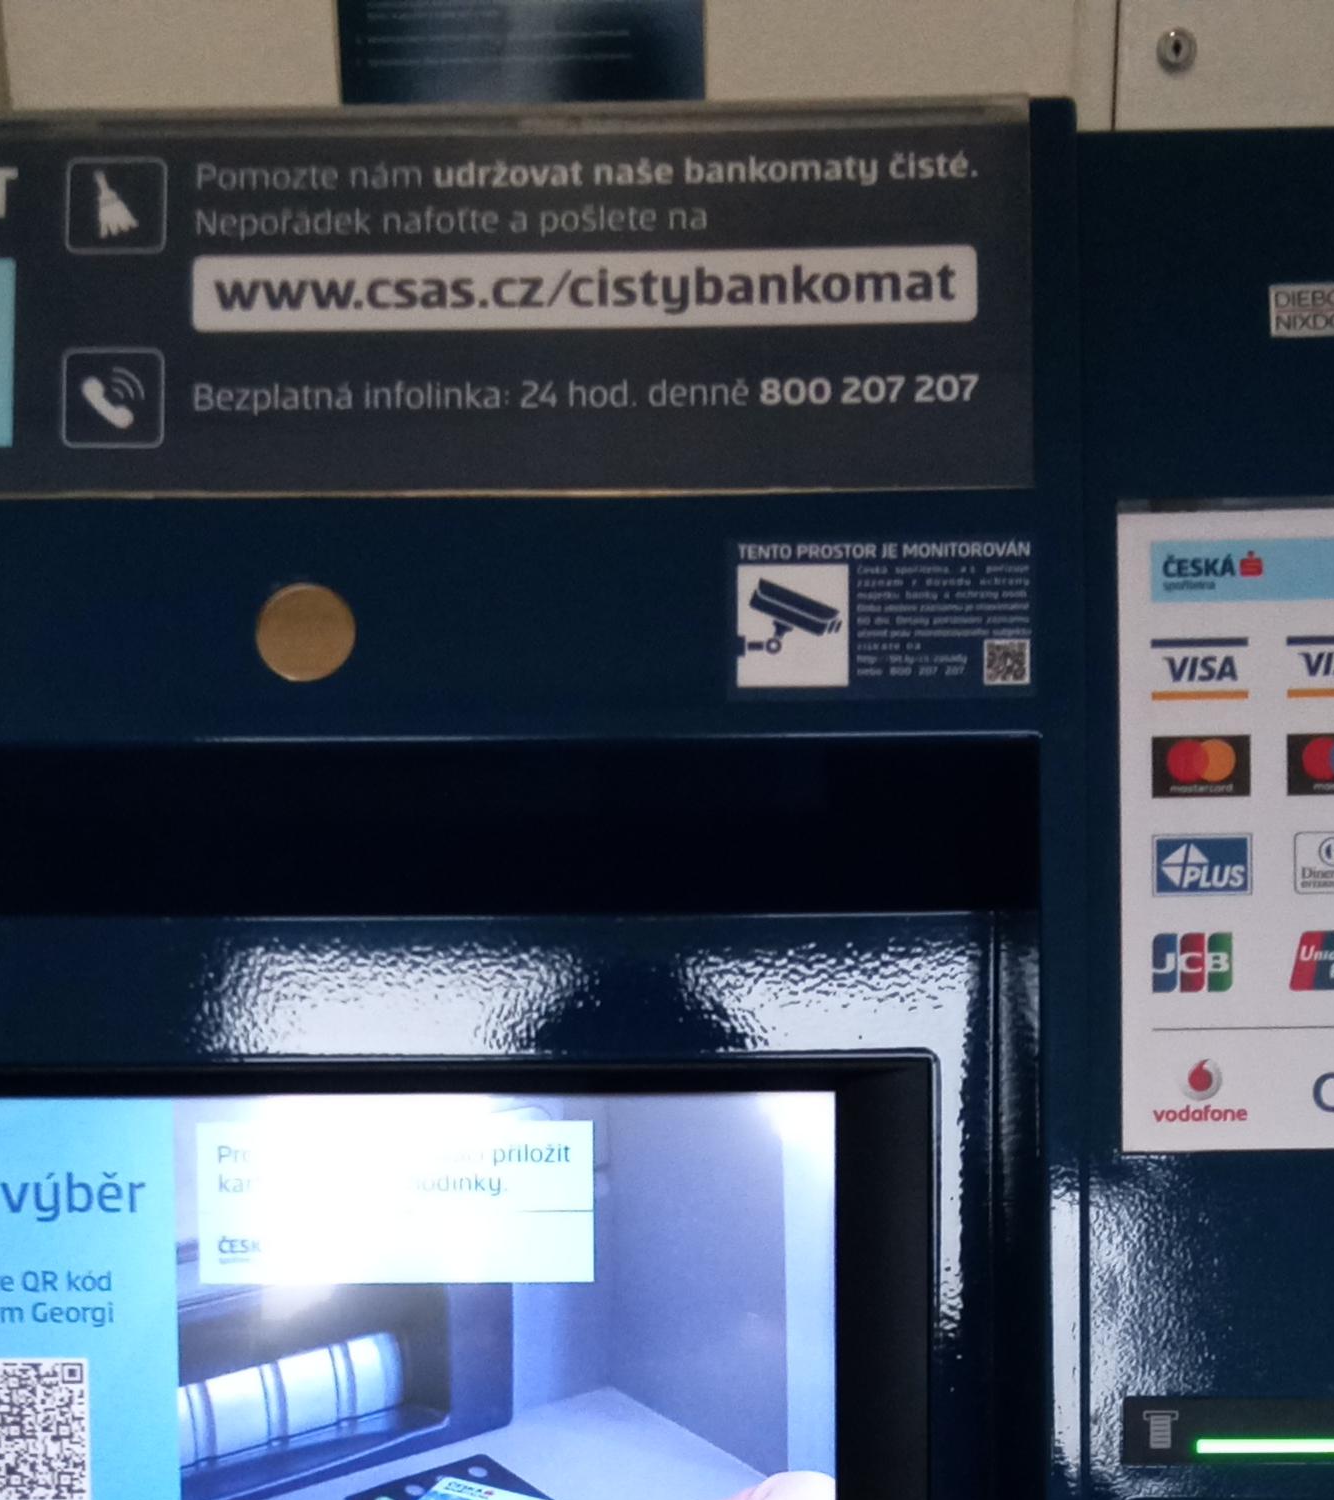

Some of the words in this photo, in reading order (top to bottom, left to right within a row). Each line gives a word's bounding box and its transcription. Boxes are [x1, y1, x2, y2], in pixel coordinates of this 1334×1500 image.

[196, 161, 339, 191] Pomozte
[349, 161, 423, 190] nám
[433, 160, 584, 189] udržovat
[593, 157, 674, 186] naše
[684, 155, 879, 187] bankomaty
[888, 150, 979, 180] čisté.
[194, 206, 371, 240] Nepořádek
[509, 212, 528, 234] a
[539, 203, 657, 239] pošlete
[668, 206, 708, 231] na
[213, 263, 956, 315] www.csas.cz/cistybankomat
[193, 381, 353, 416] Bezplatná
[364, 379, 510, 410] infolinka:
[519, 380, 558, 410] 24
[568, 379, 638, 410] hod.
[647, 377, 750, 407] denně
[759, 376, 832, 406] 800
[840, 375, 906, 404] 207
[914, 373, 980, 403] 207
[737, 543, 792, 560] TENTO
[796, 543, 877, 560] PROSTOR
[881, 543, 898, 559] JE
[902, 540, 1031, 558] MONITOROVÁN
[1162, 552, 1236, 579] ČESKÁ
[1162, 655, 1238, 683] VISA
[1169, 782, 1234, 795] mastercard
[1182, 863, 1246, 889] PLUS
[1152, 952, 1230, 974] JCB
[1153, 1104, 1248, 1123] vodafone
[492, 1144, 571, 1167] přiložit
[0, 1171, 146, 1222] výběr
[217, 1234, 262, 1255] ČESK
[21, 1270, 59, 1293] QR
[66, 1269, 113, 1292] kód
[31, 1301, 115, 1328] Georgi
